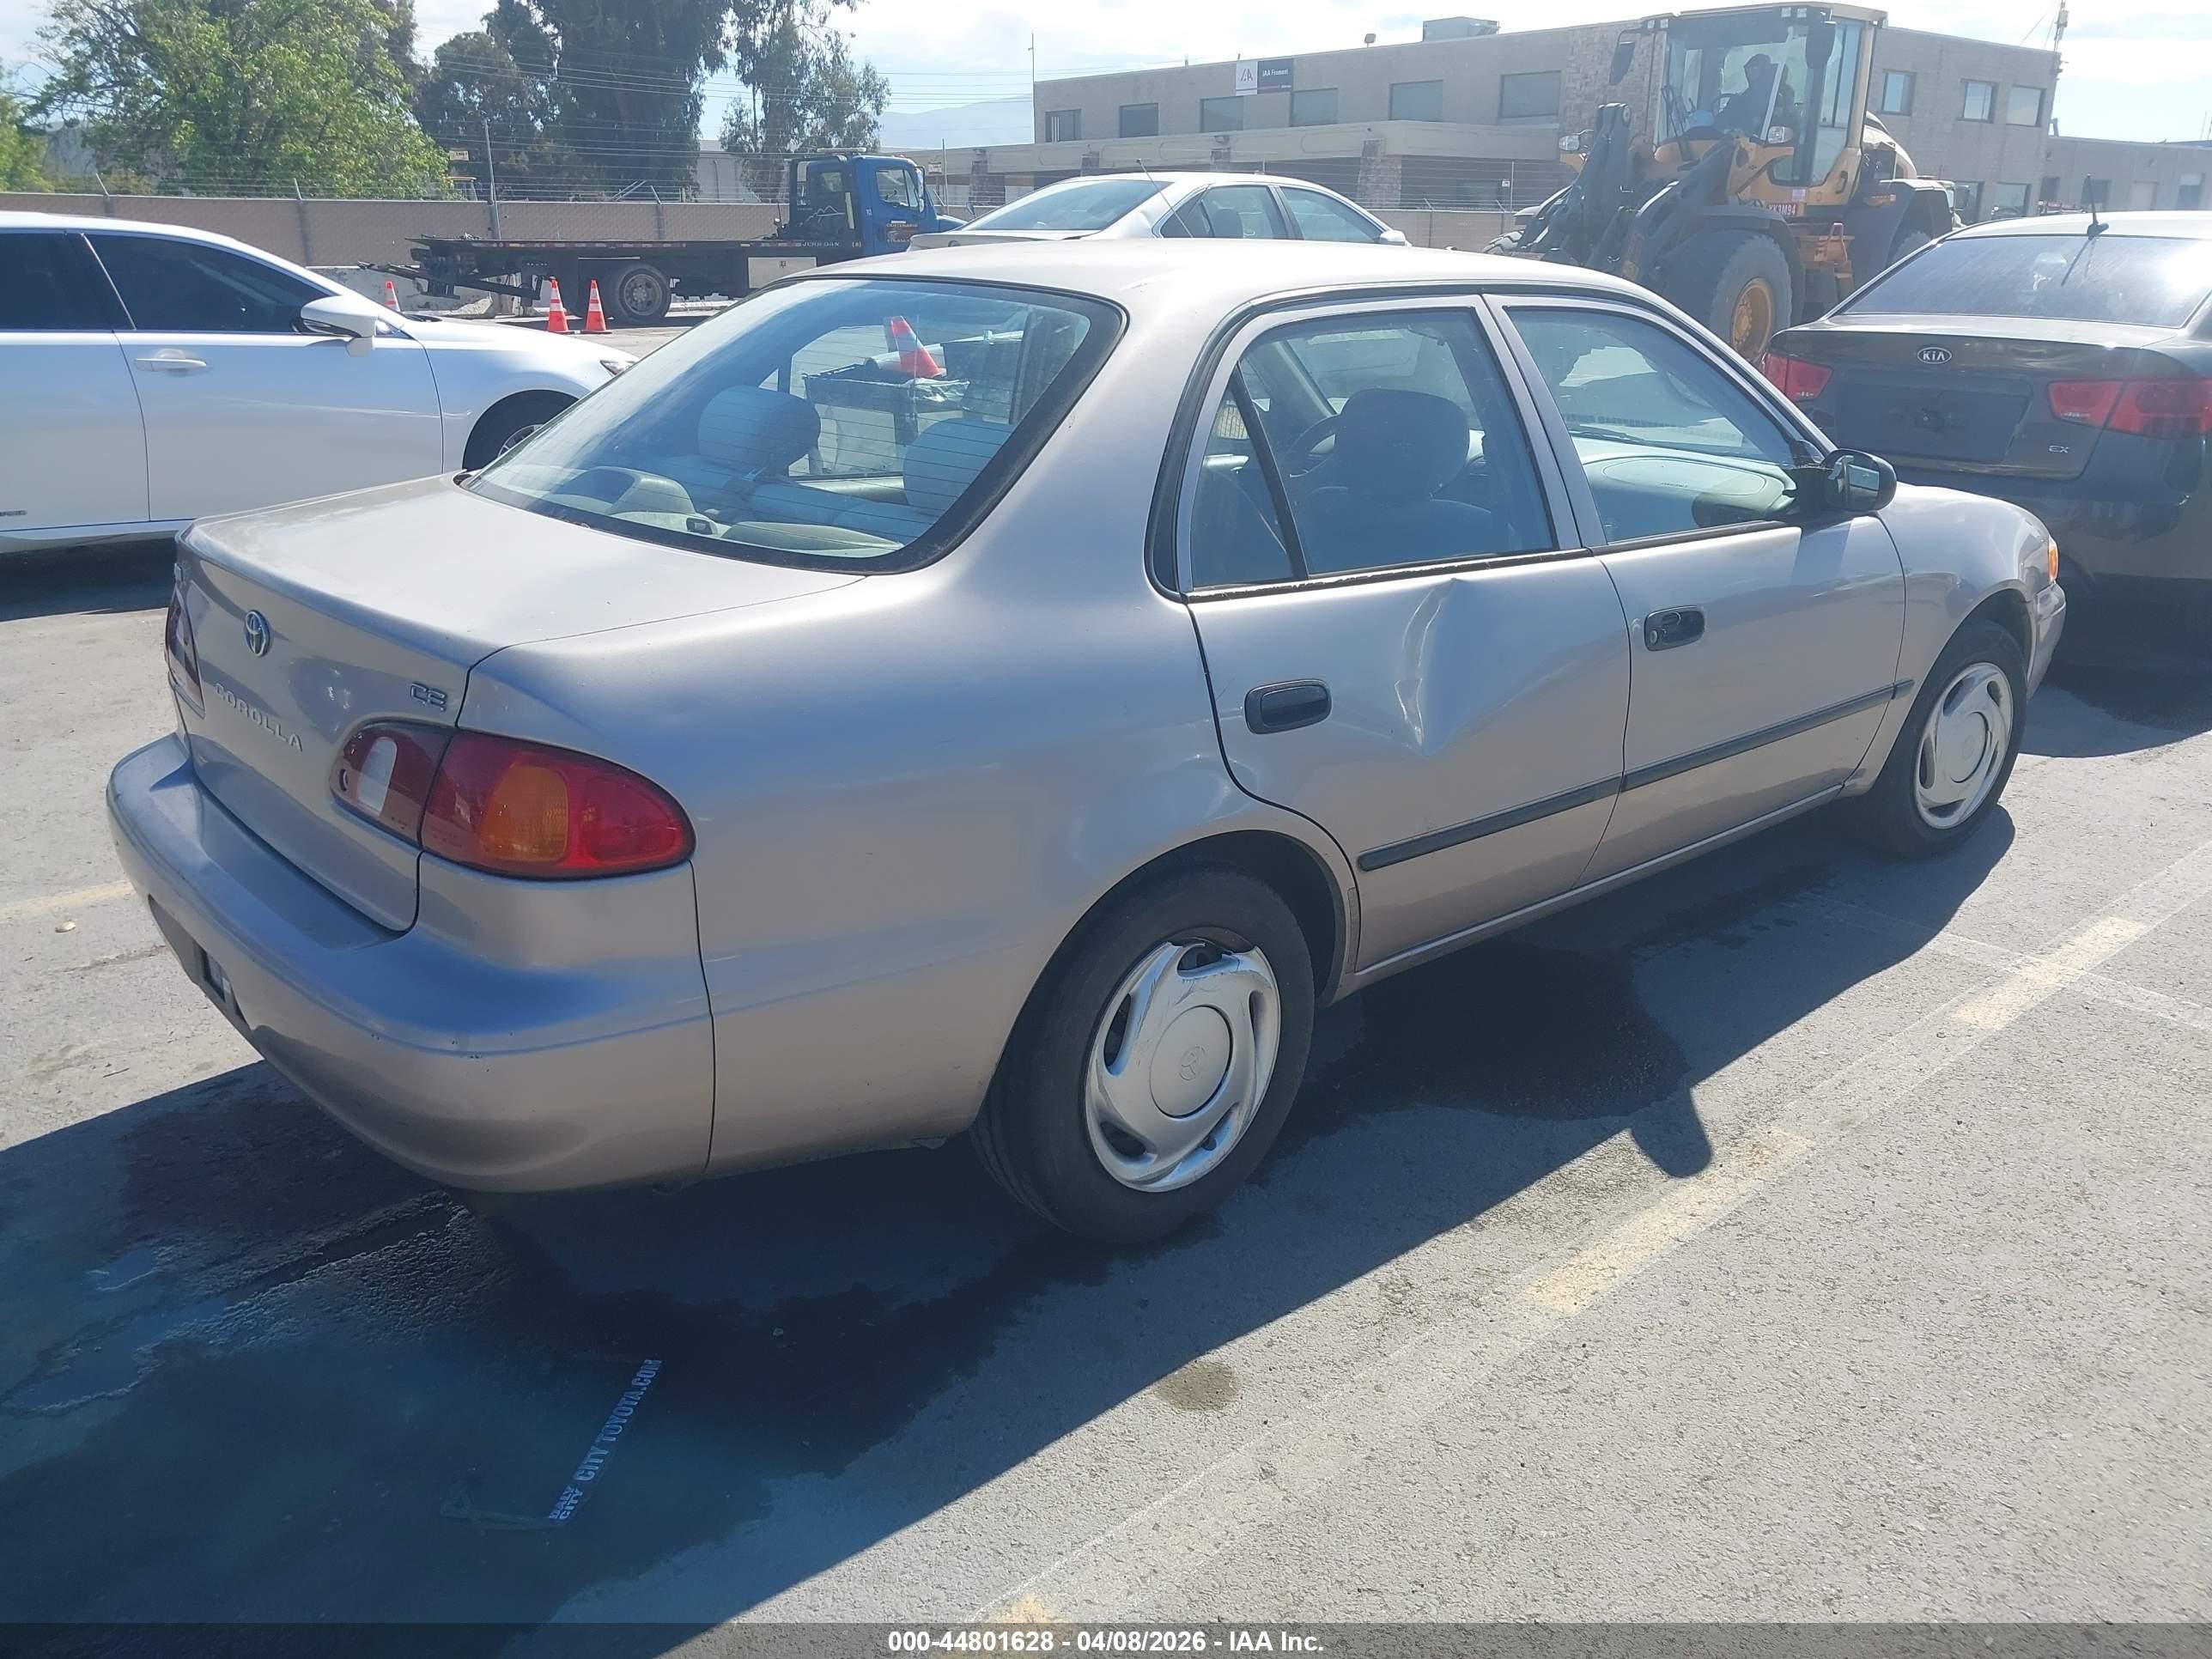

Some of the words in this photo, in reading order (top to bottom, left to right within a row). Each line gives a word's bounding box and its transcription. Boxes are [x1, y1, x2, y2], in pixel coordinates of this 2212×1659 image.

[2049, 445, 2069, 453] EX
[214, 683, 303, 752] COROLLA
[410, 683, 447, 712] CE
[576, 1446, 610, 1481] CITY
[595, 1359, 663, 1443] TOYOTA.COM
